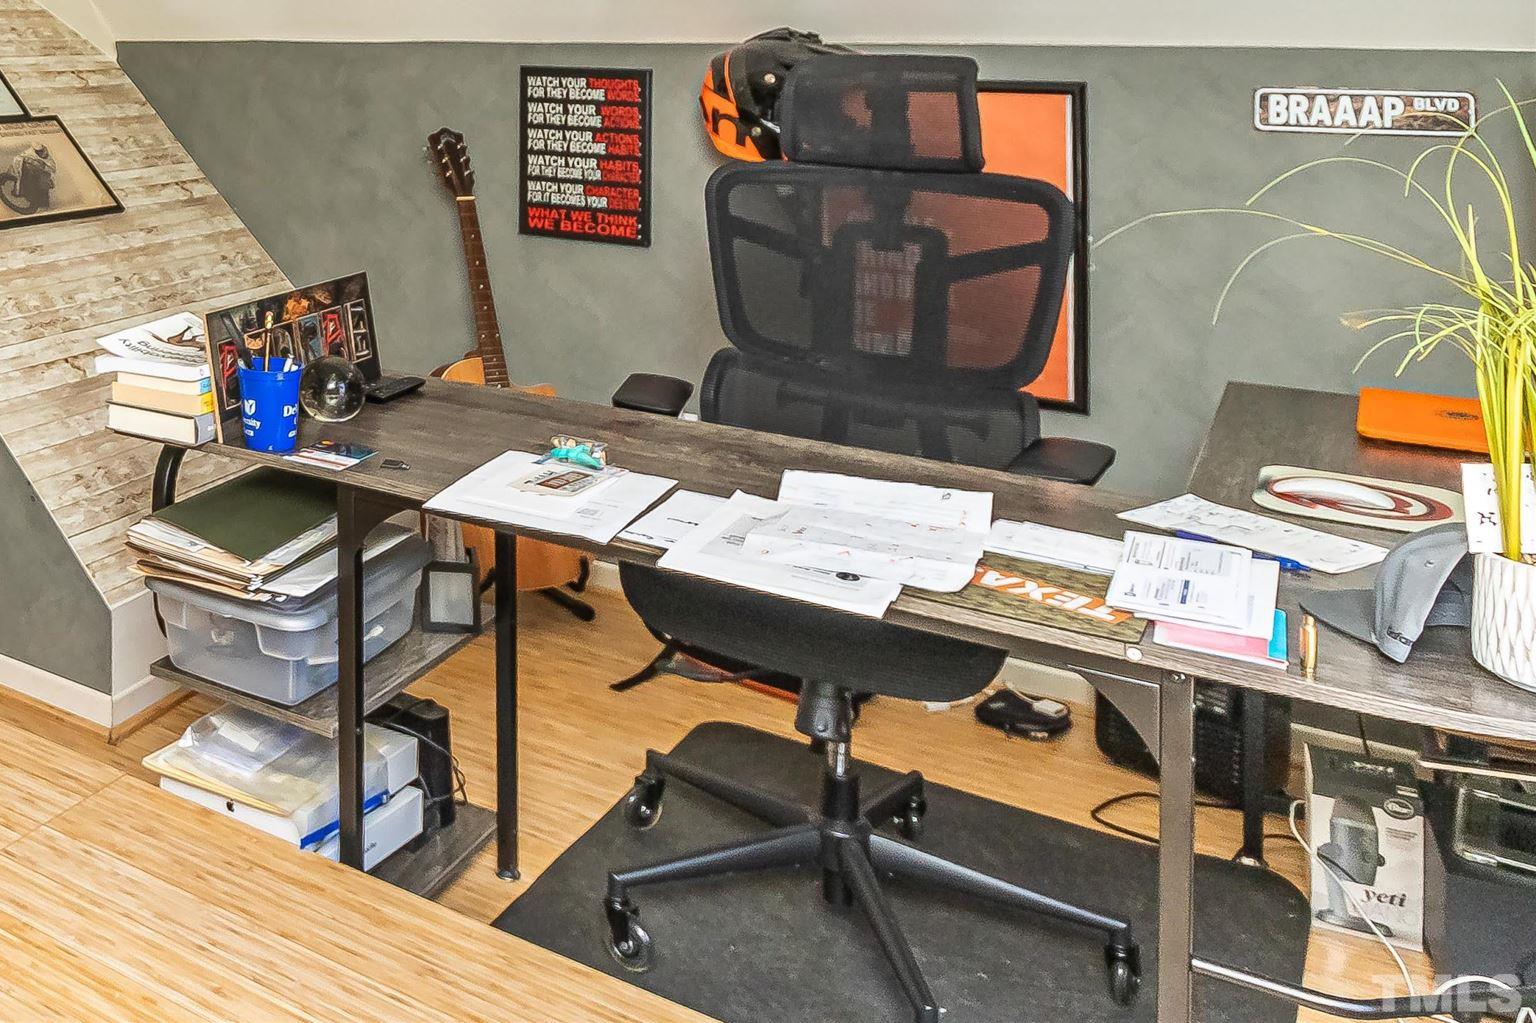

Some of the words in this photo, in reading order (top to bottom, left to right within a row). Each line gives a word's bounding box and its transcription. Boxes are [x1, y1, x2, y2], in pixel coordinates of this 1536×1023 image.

[527, 76, 559, 87] WATCH
[561, 78, 586, 88] YOUR
[527, 87, 544, 97] FOR
[546, 88, 567, 98] THEY
[569, 88, 605, 101] BECOME
[527, 102, 563, 114] WATCH
[568, 104, 596, 115] YOUR
[1267, 93, 1405, 128] BRAAAP
[1414, 96, 1460, 113] BLVD
[527, 113, 543, 124] FOR
[546, 114, 566, 125] THEY
[568, 115, 602, 127] BECOME
[527, 128, 563, 140] WATCH
[565, 130, 593, 141] YOUR
[527, 139, 544, 150] FOR
[547, 140, 568, 151] THEY
[570, 141, 606, 154] BECOME
[527, 154, 565, 166] WATCH
[568, 156, 597, 169] YOUR
[527, 166, 540, 176] FOR
[541, 167, 556, 177] THEY
[557, 167, 583, 180] BECOME
[584, 168, 602, 181] YOUR
[527, 180, 558, 192] WATCH
[559, 183, 583, 194] YOUR
[527, 191, 543, 202] FOR
[544, 192, 550, 203] IT
[551, 193, 585, 207] BECOMES
[587, 196, 608, 208] YOUR
[527, 207, 566, 220] WHAT
[571, 210, 592, 222] WE
[528, 218, 554, 230] WE
[976, 567, 1116, 621] TEXA
[1360, 889, 1407, 907] yeti
